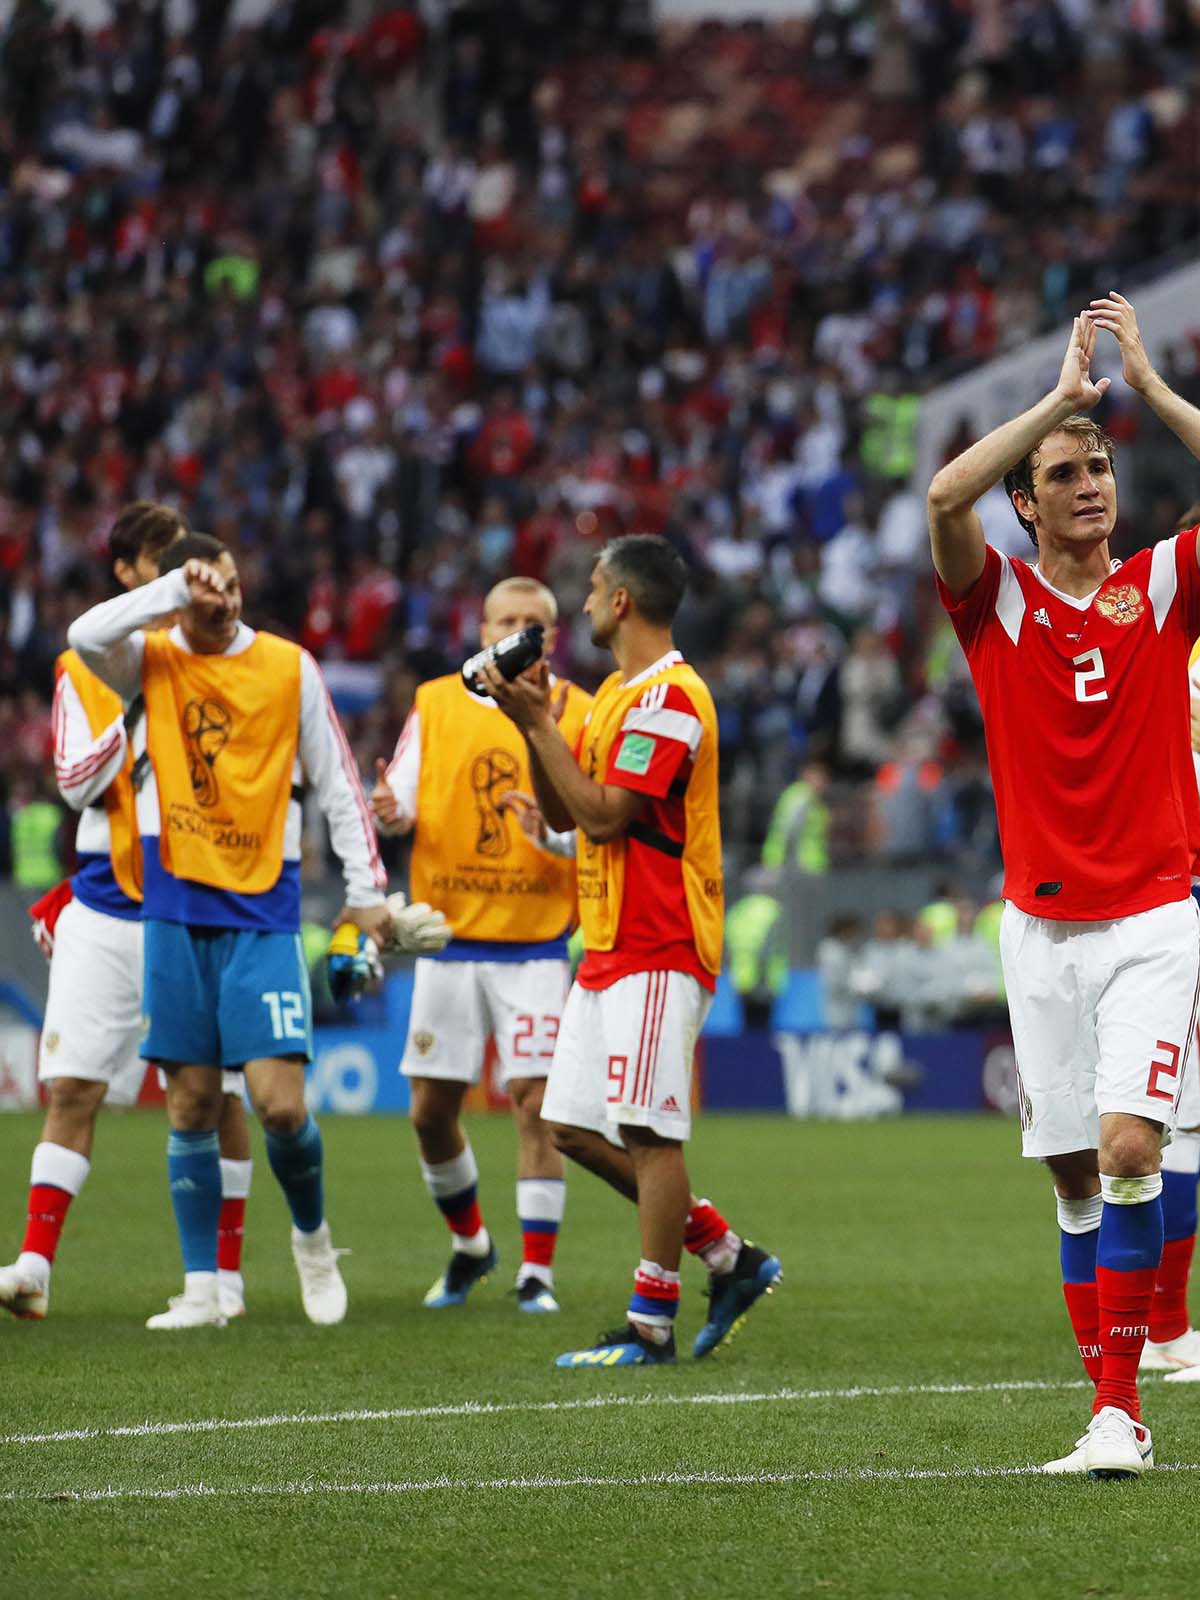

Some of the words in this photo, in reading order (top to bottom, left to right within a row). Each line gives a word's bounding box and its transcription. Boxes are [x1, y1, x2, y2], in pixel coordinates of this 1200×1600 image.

[1072, 646, 1108, 702] 2
[261, 991, 306, 1039] 12
[514, 1015, 560, 1057] 23
[607, 1055, 628, 1103] 9
[1146, 1039, 1181, 1104] 2
